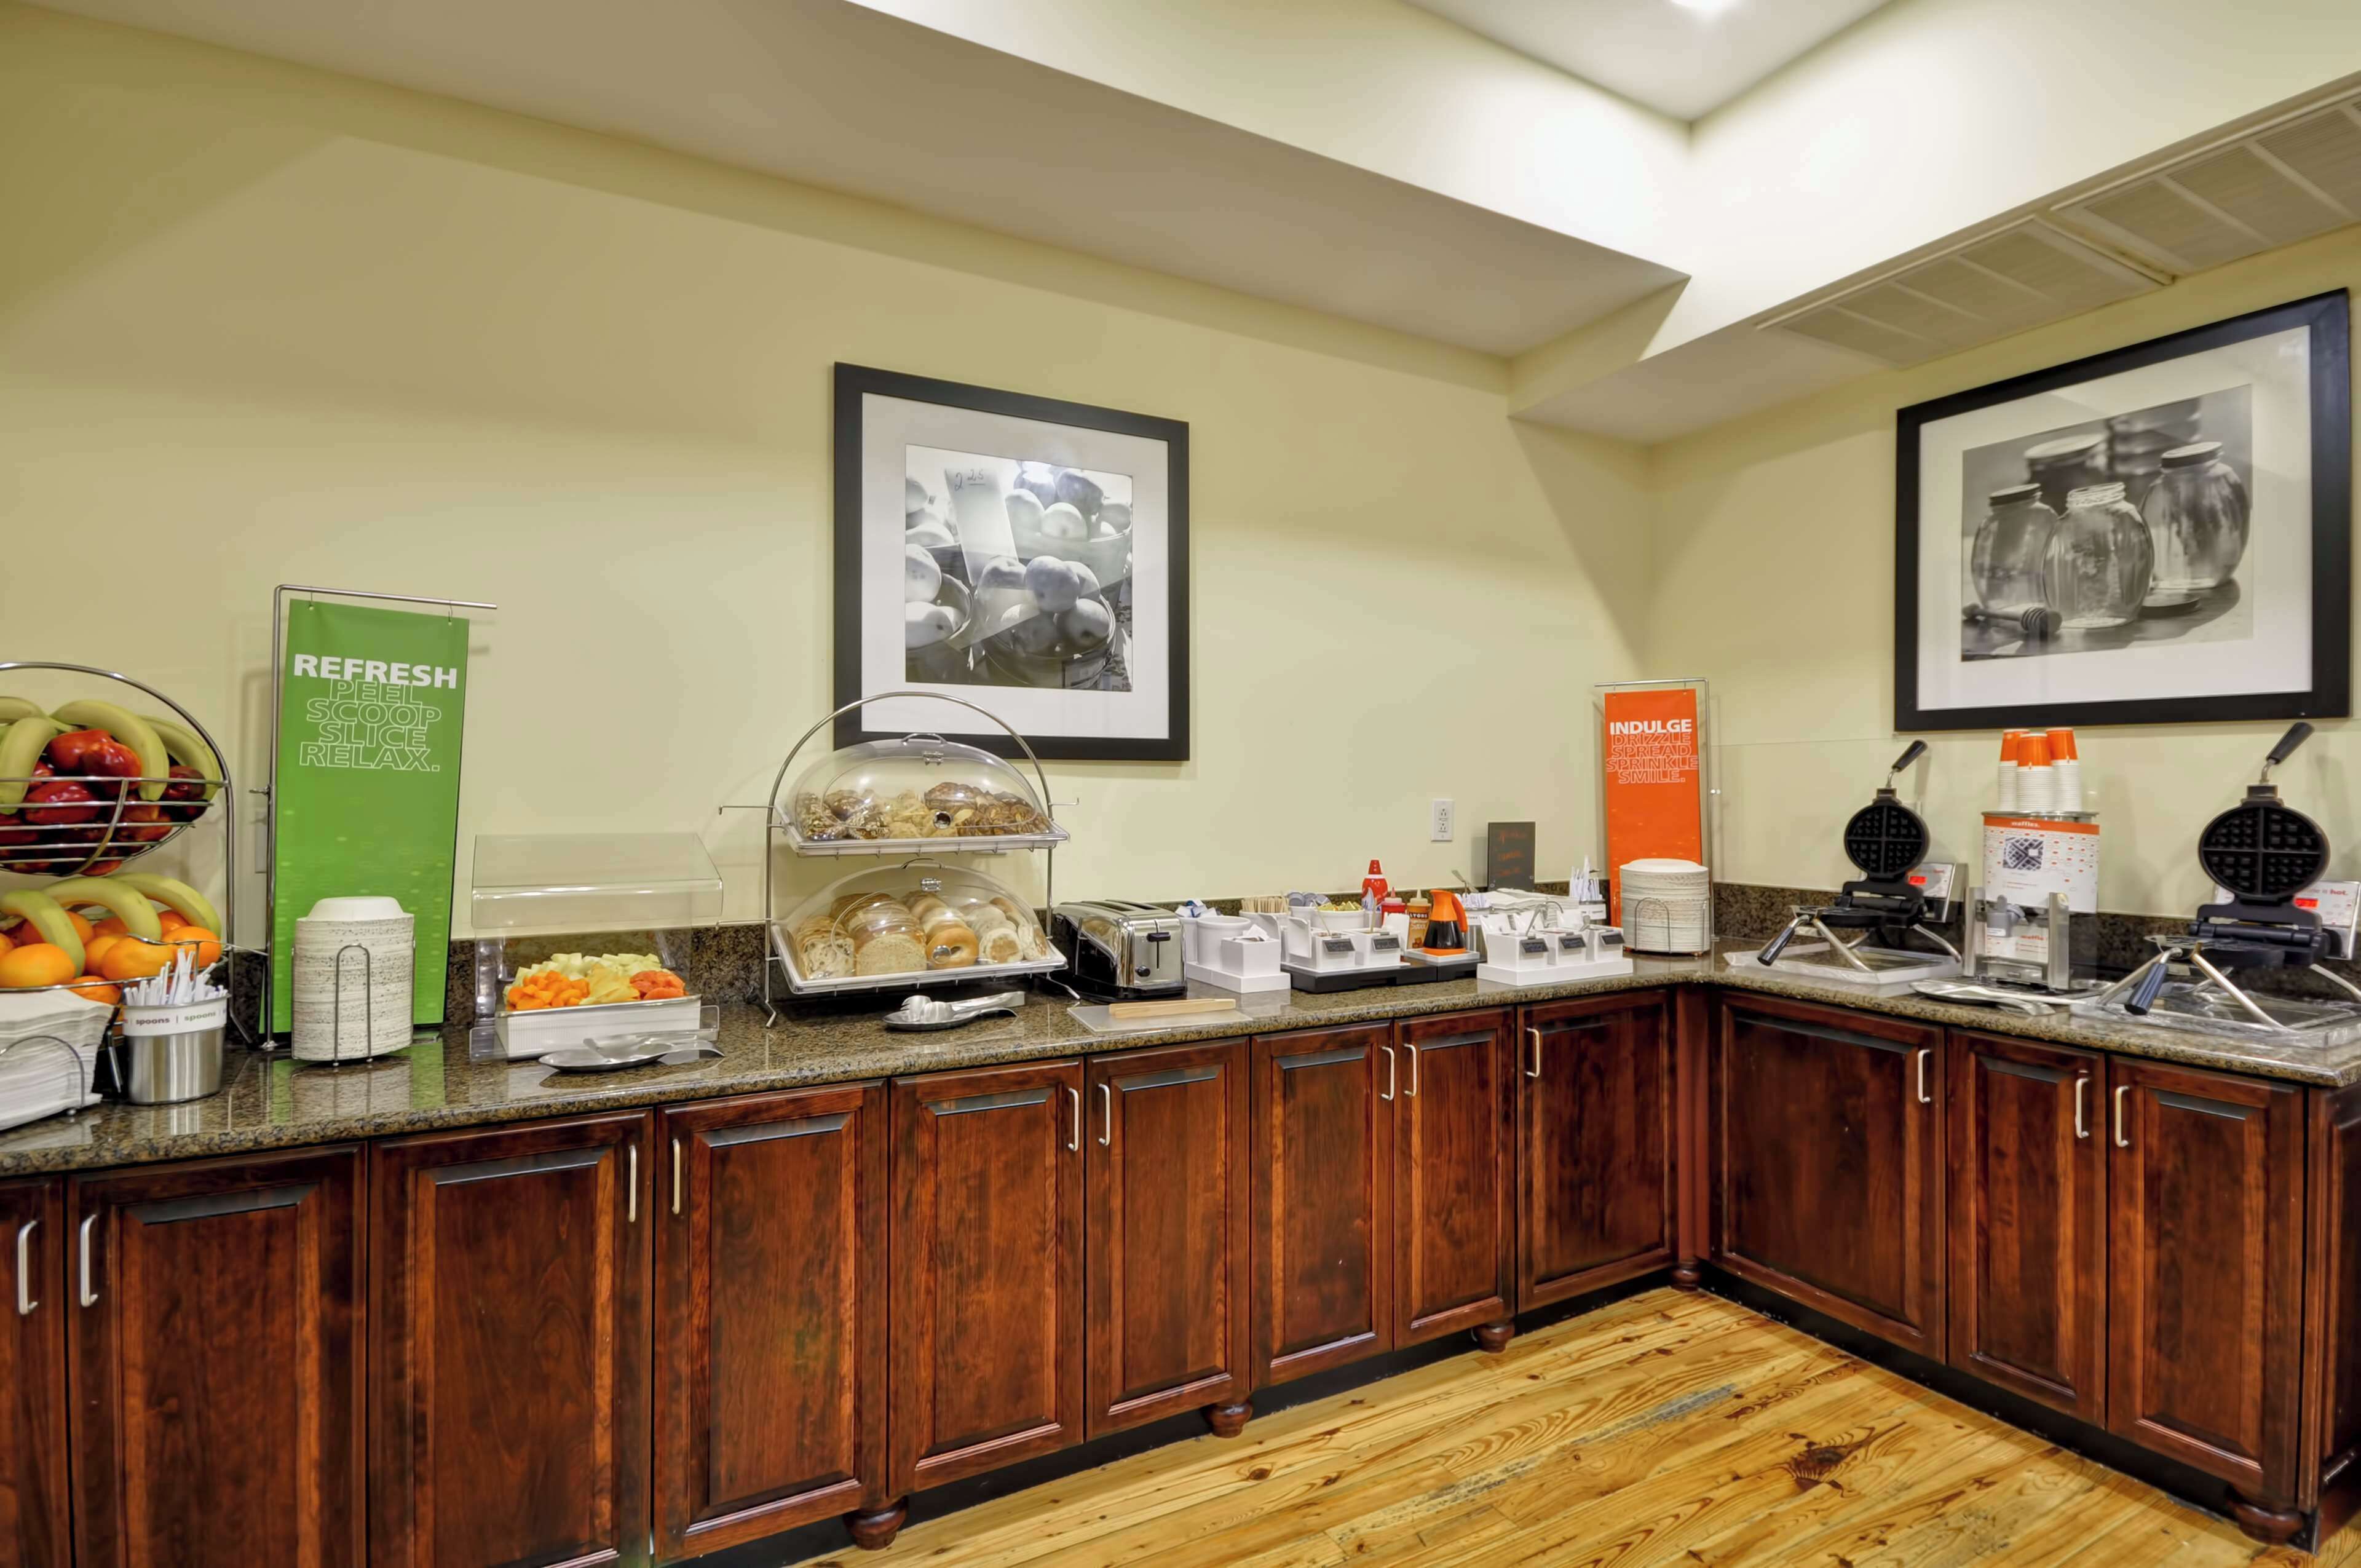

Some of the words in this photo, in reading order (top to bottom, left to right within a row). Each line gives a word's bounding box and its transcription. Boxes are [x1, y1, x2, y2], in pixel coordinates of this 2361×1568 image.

[294, 654, 457, 689] REFRESH
[330, 678, 422, 707] PEEL
[306, 698, 441, 728] SCOOP
[319, 722, 426, 749] SLICE
[1610, 719, 1692, 735] INDULGE
[1612, 732, 1691, 746] DRIZZLE
[299, 742, 440, 772] RELAX.
[1612, 744, 1692, 759] SPREAD
[1605, 755, 1698, 772] SPRINKLE
[1619, 769, 1685, 784] SMILE.
[184, 1012, 216, 1021] spoons
